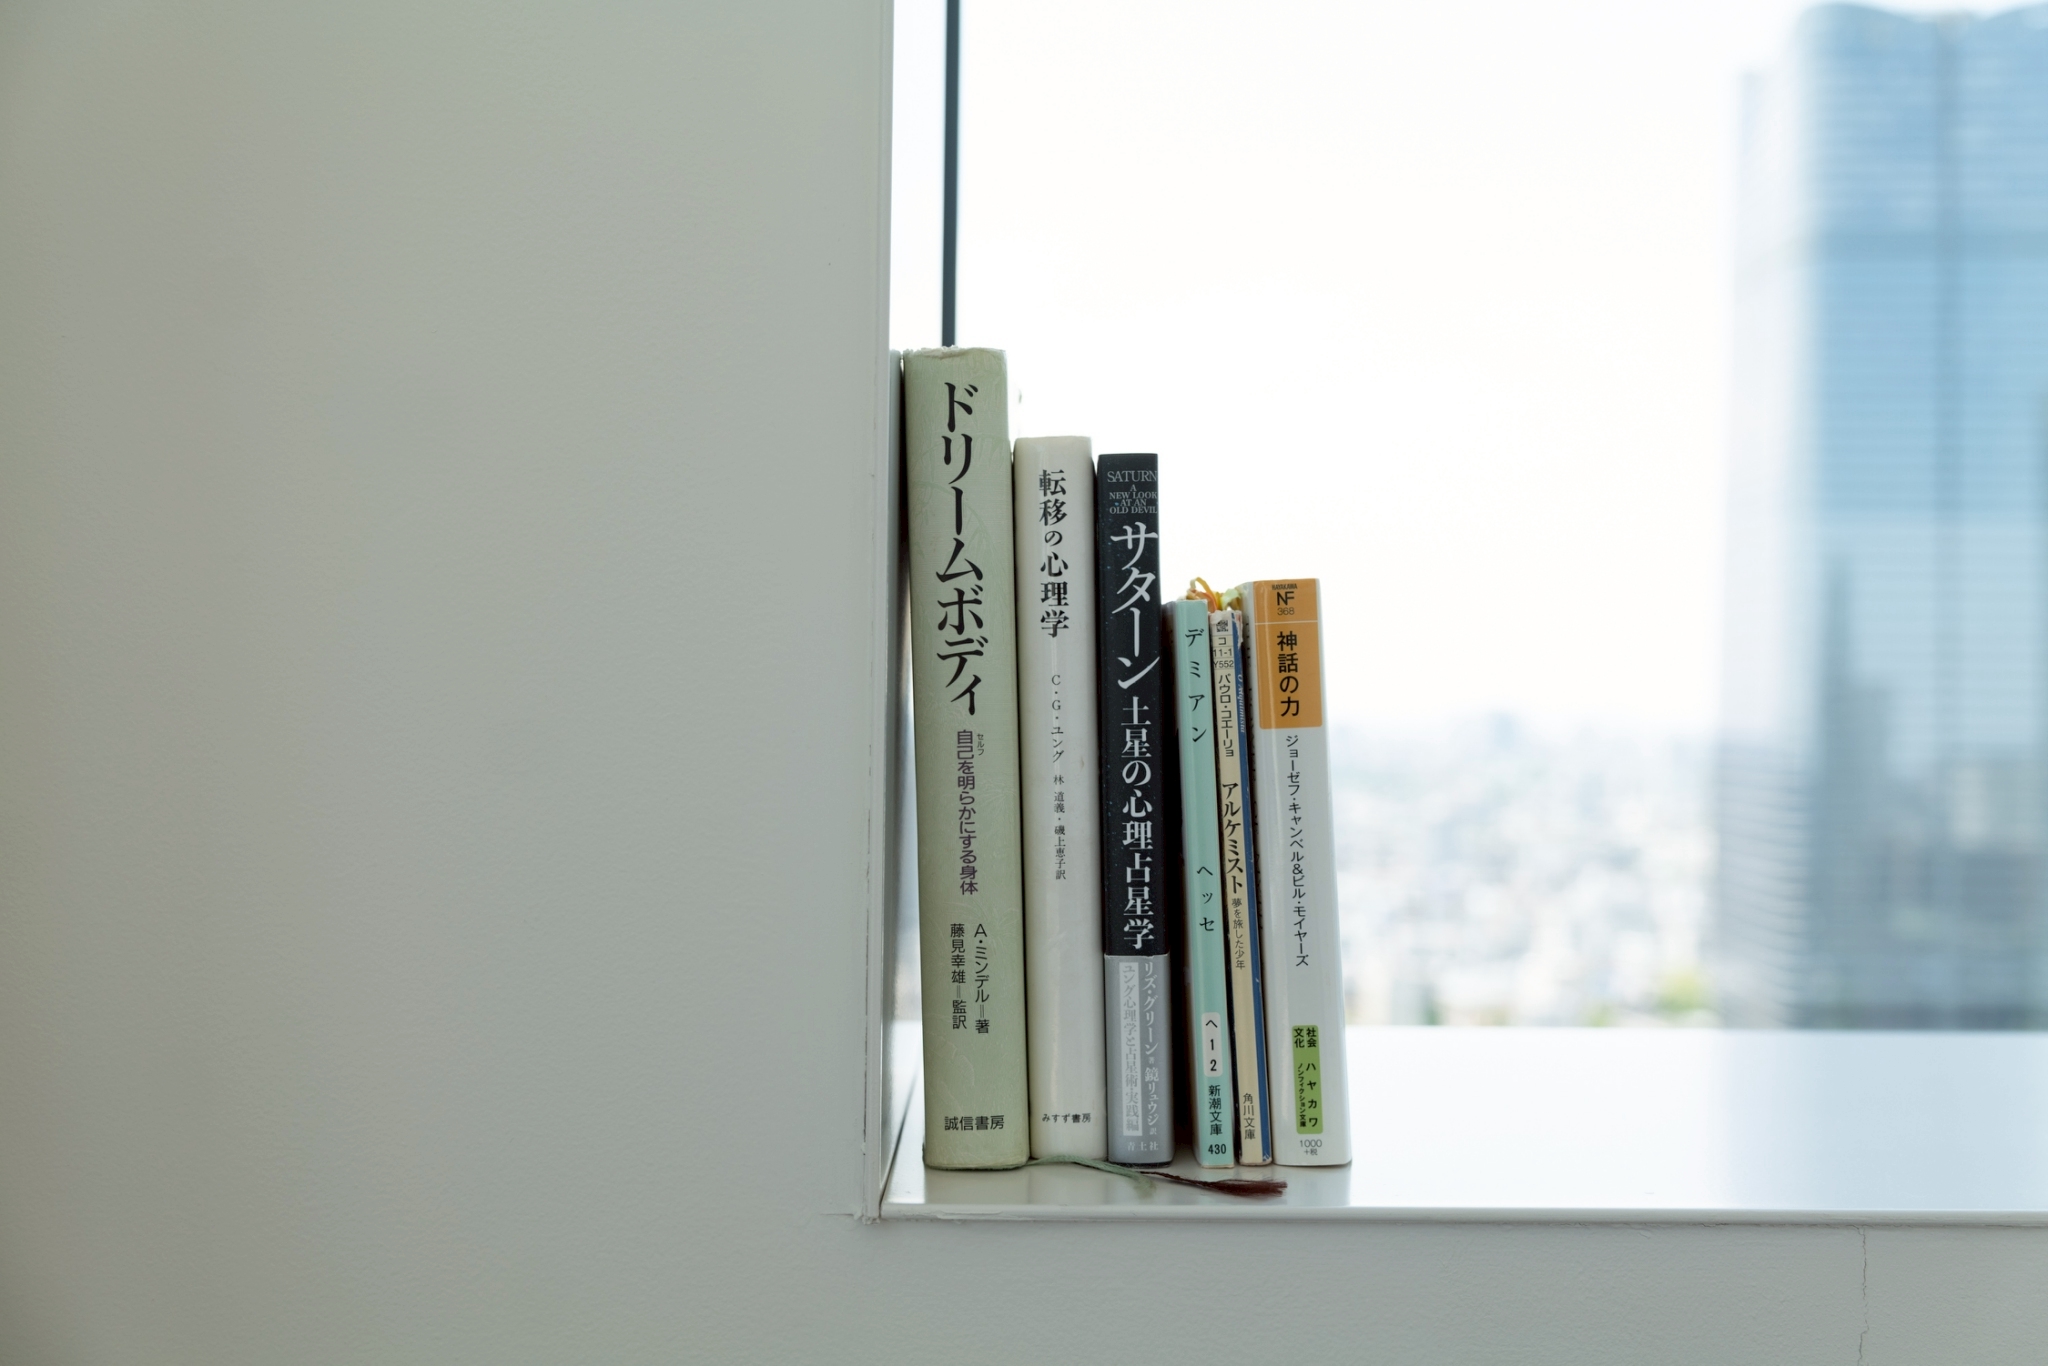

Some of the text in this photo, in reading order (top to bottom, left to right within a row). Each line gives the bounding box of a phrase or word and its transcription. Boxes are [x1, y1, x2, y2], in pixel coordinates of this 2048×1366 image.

[1107, 470, 1158, 482] SATURN
[1133, 491, 1158, 499] LOOK
[1109, 506, 1129, 514] OLD
[936, 382, 988, 716] ドリームボディ
[1039, 469, 1069, 638] 転移の心理学
[1277, 591, 1295, 606] NF
[1277, 607, 1295, 616] 368
[1184, 628, 1207, 743] デミアン
[1277, 630, 1300, 717] 神話の力
[1110, 521, 1160, 949] サターン 土星の心理占星学
[1218, 673, 1234, 757] パウロ・コエーリョ
[977, 733, 985, 756] セルフ
[956, 729, 979, 896] 自己を明らかにする身体
[1222, 782, 1244, 894] アルケミスト
[1196, 866, 1215, 932] ヘッセ
[1231, 898, 1246, 970] 夢を旅した少年
[1293, 1027, 1305, 1048] 文化
[1306, 1027, 1317, 1048] 社会
[1042, 1112, 1091, 1123] みすず書房
[1208, 1084, 1223, 1136] 新潮文庫
[1243, 1093, 1256, 1140] 角川文庫
[1297, 1063, 1306, 1127] ノンフィクション文庫
[1306, 1062, 1318, 1127] ハヤカワ
[944, 1114, 1005, 1131] 誠信書房
[1299, 1139, 1323, 1148] 1000
[1127, 1141, 1159, 1152] 青土社
[1208, 1144, 1227, 1154] 430
